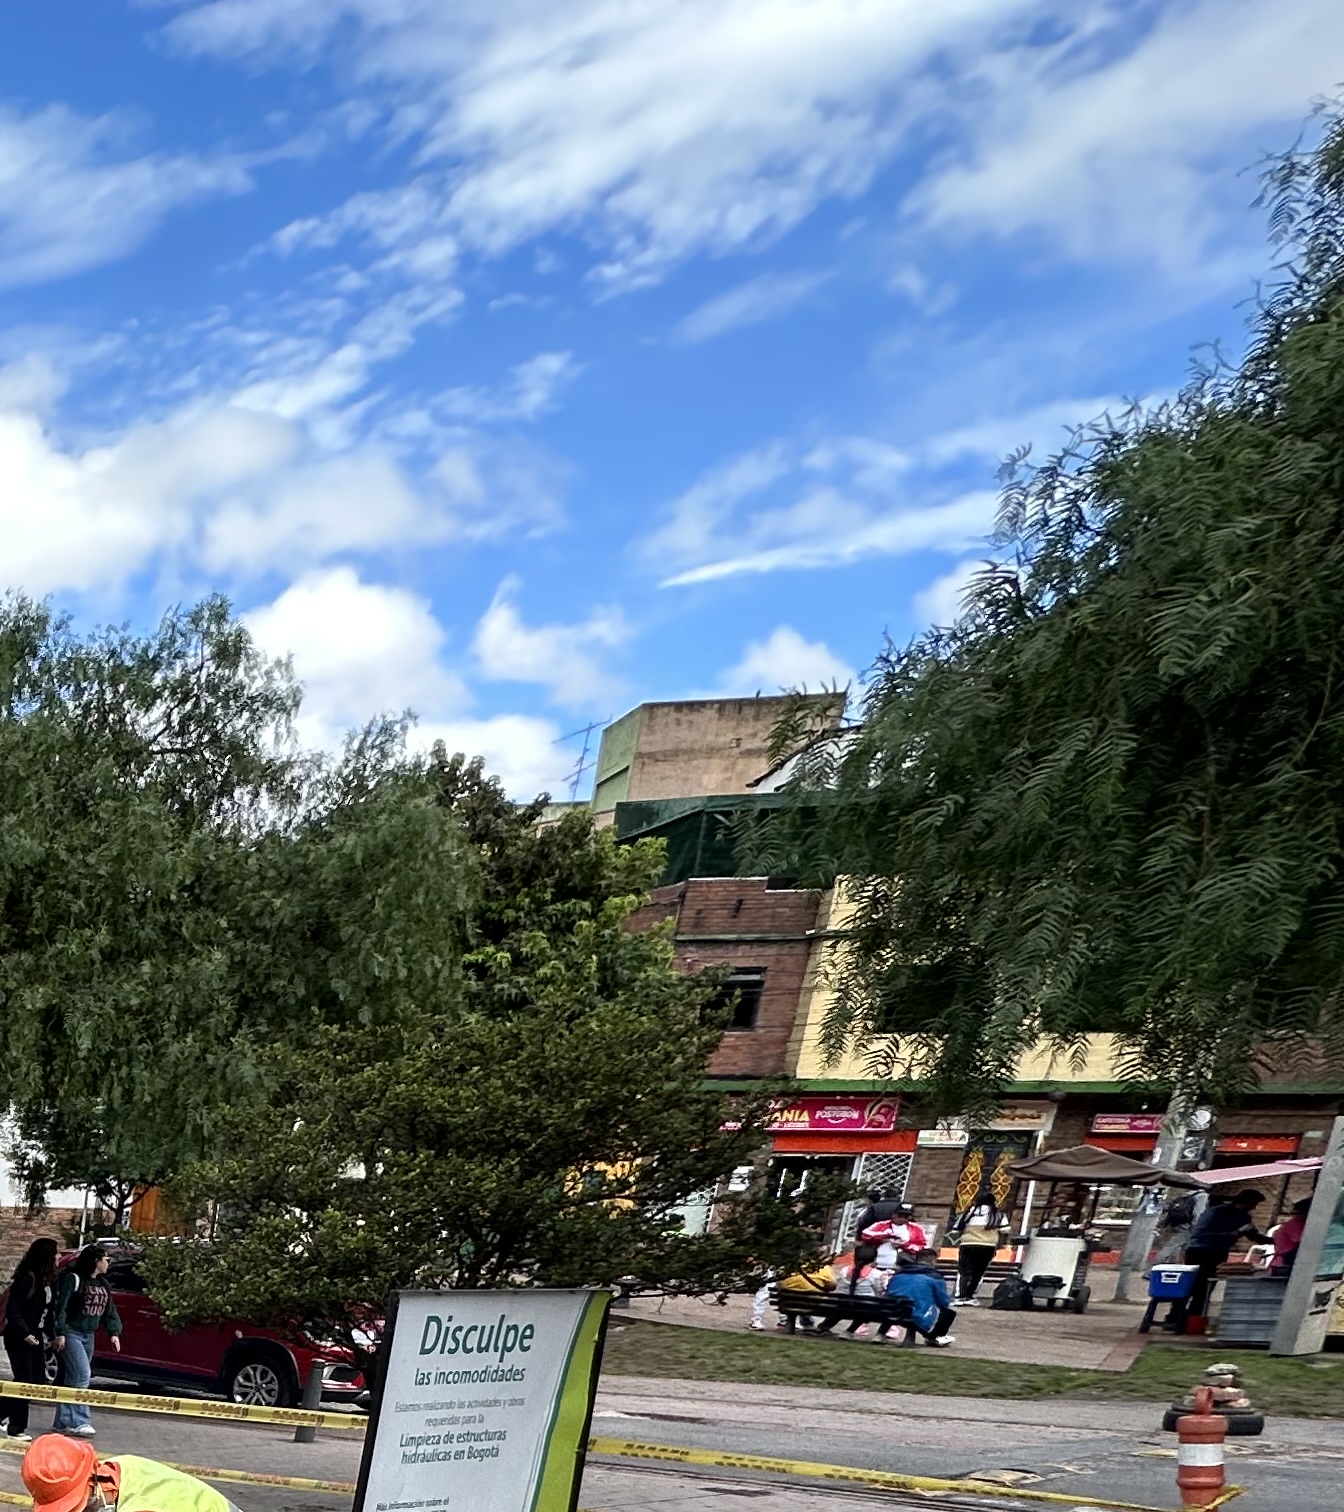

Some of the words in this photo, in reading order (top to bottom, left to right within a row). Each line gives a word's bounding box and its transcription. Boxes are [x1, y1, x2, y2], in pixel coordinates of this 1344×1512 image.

[419, 1314, 535, 1363] Disculpe
[415, 1368, 432, 1386] las
[434, 1364, 527, 1386] incomodidades
[461, 1414, 477, 1427] para
[478, 1413, 485, 1424] la
[400, 1432, 441, 1449] Limpieza
[443, 1430, 455, 1445] de
[456, 1429, 507, 1444] estructuras
[401, 1448, 452, 1465] hidráulicas
[454, 1450, 465, 1461] en
[467, 1444, 500, 1462] Bogotá
